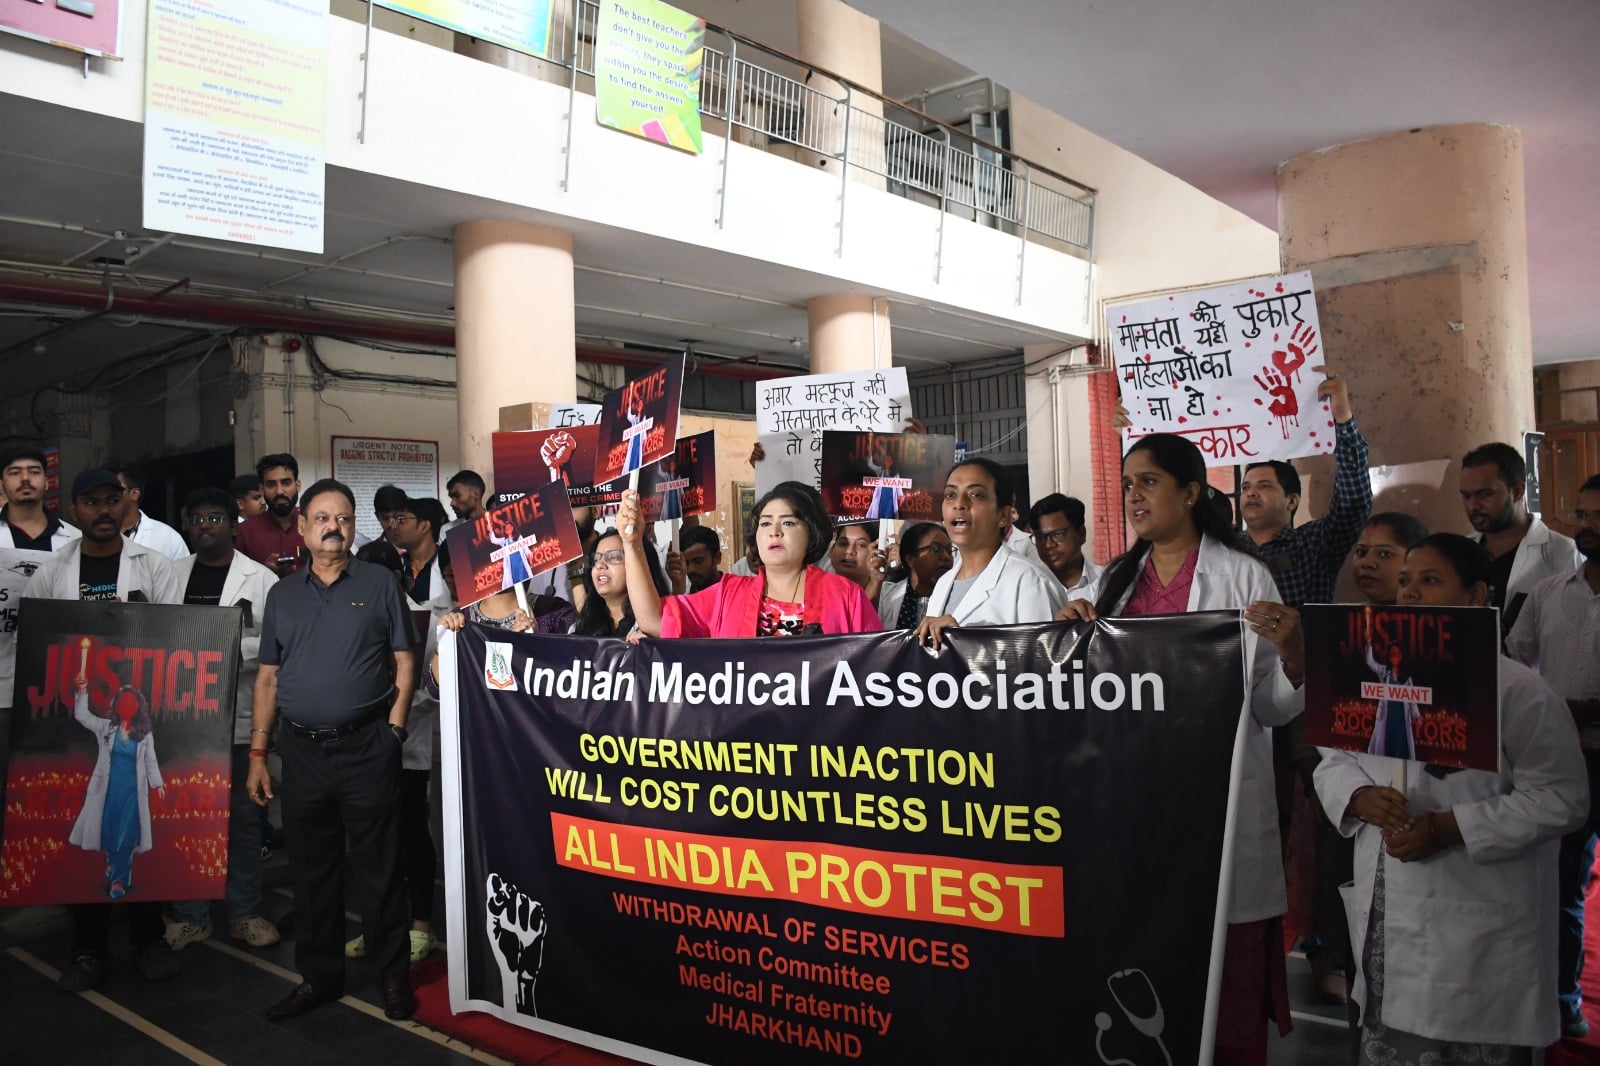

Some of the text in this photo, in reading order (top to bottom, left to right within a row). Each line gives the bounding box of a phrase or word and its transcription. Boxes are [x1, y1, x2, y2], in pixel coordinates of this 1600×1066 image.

[614, 3, 687, 40] The best teachers
[612, 23, 685, 57] don't give you the
[604, 57, 688, 91] within you the desire
[643, 51, 661, 66] they
[609, 73, 683, 105] to find the answer
[631, 98, 666, 114] yourself.
[1117, 289, 1311, 352] मानवता की यही पुकार
[616, 368, 667, 417] JUSTICE
[763, 385, 792, 410] अगर
[863, 373, 887, 395] नहीं
[1147, 385, 1205, 421] ना हो
[887, 398, 903, 423] में
[352, 441, 420, 451] URGENT NOTICE
[624, 420, 652, 439] WE WANT
[786, 431, 803, 456] तो
[340, 449, 434, 463] RAGGING STRICTLY PROHIBITED
[849, 435, 927, 465] JUSTICE
[590, 492, 621, 502] CRIME
[594, 484, 612, 493] THE
[669, 480, 689, 489] WANT
[864, 478, 910, 487] WE WANT
[472, 493, 544, 547] JUSTICE
[493, 536, 535, 560] WE WANT
[91, 583, 117, 593] MEDIC
[1339, 611, 1455, 662] JUSTICE
[27, 644, 223, 718] JUSTICE
[523, 657, 1165, 712] Indian Medical Association
[1363, 684, 1429, 701] WE WANT
[579, 733, 995, 788] GOVERNMENT INACTION
[545, 767, 1062, 843] WILL COST COUNTLESS LIVES
[564, 824, 1043, 927] ALL INDIA PROTEST
[612, 891, 970, 970] WITHDRAWAL OF SERVICES
[676, 933, 891, 995] Action Committee
[678, 963, 893, 1036] Medical Fraternity
[705, 1002, 862, 1059] JHARKHAND
